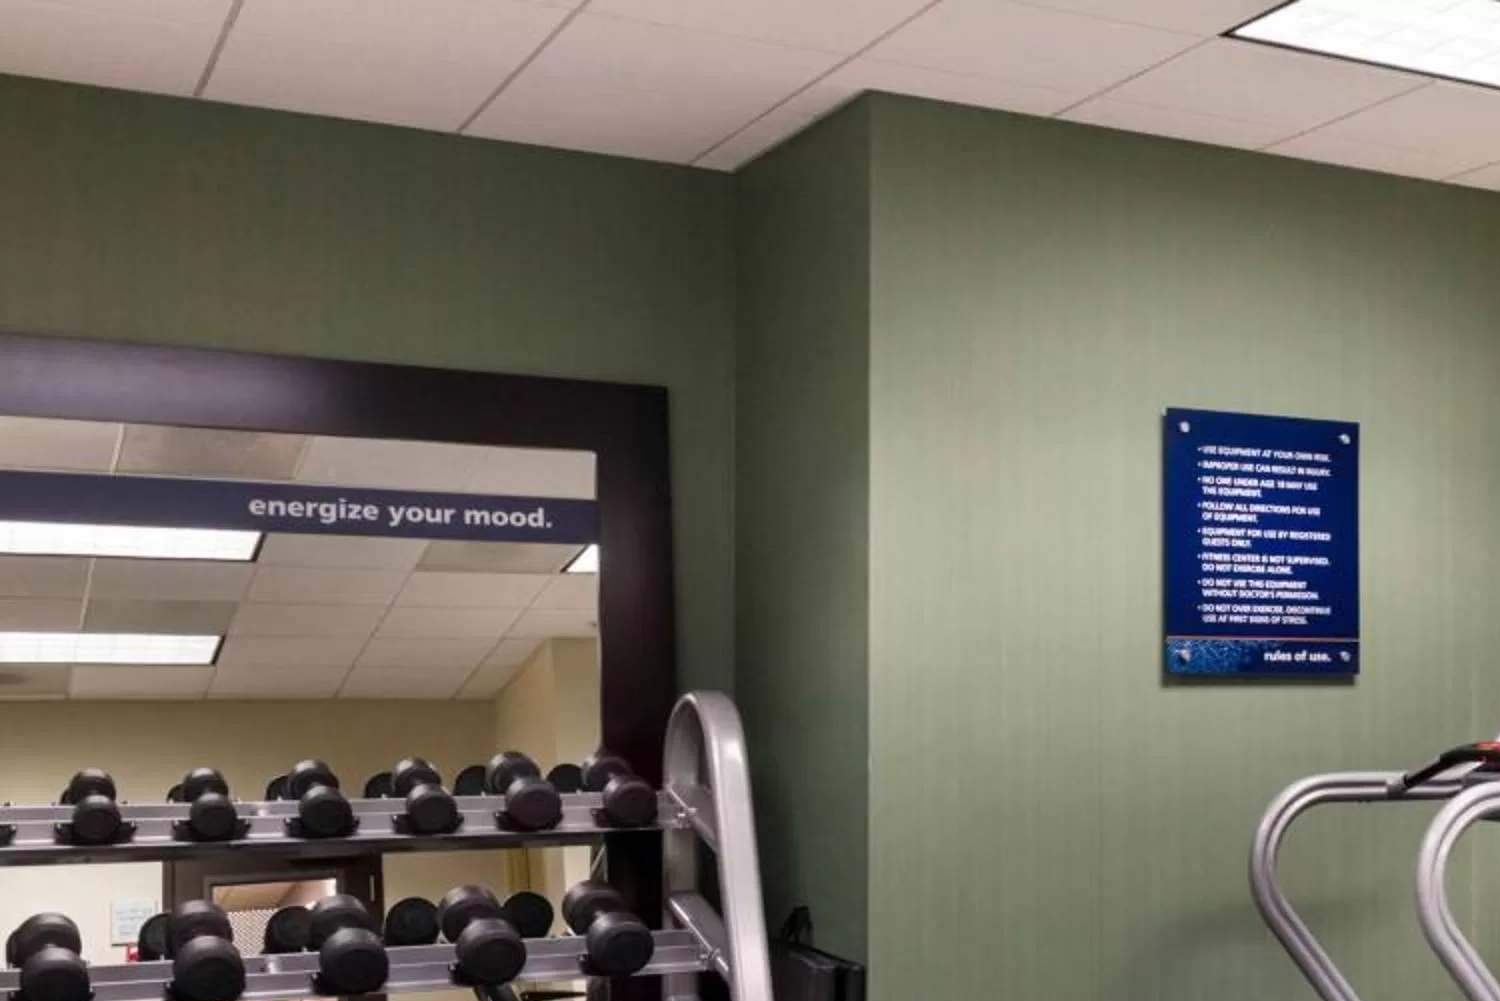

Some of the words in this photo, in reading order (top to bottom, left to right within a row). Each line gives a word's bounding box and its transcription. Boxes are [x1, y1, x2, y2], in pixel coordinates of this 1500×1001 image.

[1217, 446, 1261, 457] EQUIPMENT
[1261, 449, 1272, 458] AT
[1273, 450, 1294, 460] YOUR
[1255, 463, 1271, 473] CAN
[1201, 475, 1215, 485] NO
[1215, 476, 1232, 485] ONE
[1233, 477, 1259, 487] UNDER
[1259, 479, 1275, 489] AGE
[1303, 482, 1318, 491] USE
[248, 498, 379, 524] energize
[387, 504, 456, 528] your
[463, 507, 553, 529] mood.
[1201, 501, 1234, 511] FOLLOW
[1234, 503, 1248, 512] ALL
[1249, 503, 1291, 515] DIRECTIONS
[1291, 505, 1307, 515] FOR
[1307, 506, 1321, 516] USE
[1201, 511, 1213, 521] OF
[1201, 526, 1246, 537] EQUIPMENT
[1247, 529, 1262, 538] FOR
[1263, 529, 1277, 539] USE
[1277, 530, 1289, 540] BY
[1289, 531, 1332, 542] REGISTERED
[1201, 537, 1230, 548] GUESTS
[1201, 551, 1231, 562] FITNESS
[1231, 553, 1260, 563] CENTER
[1269, 555, 1285, 565] NOT
[1201, 563, 1215, 572] DO
[1215, 563, 1232, 573] NOT
[1232, 563, 1265, 573] EXERCISE
[1201, 578, 1215, 587] DO
[1215, 578, 1232, 588] NOT
[1265, 580, 1308, 590] EQUIPMENT
[1201, 588, 1238, 598] WITHOUT
[1201, 603, 1215, 613] DO
[1215, 603, 1231, 613] NOT
[1263, 649, 1292, 662] rules
[1294, 649, 1307, 662] of
[1309, 652, 1333, 662] use.
